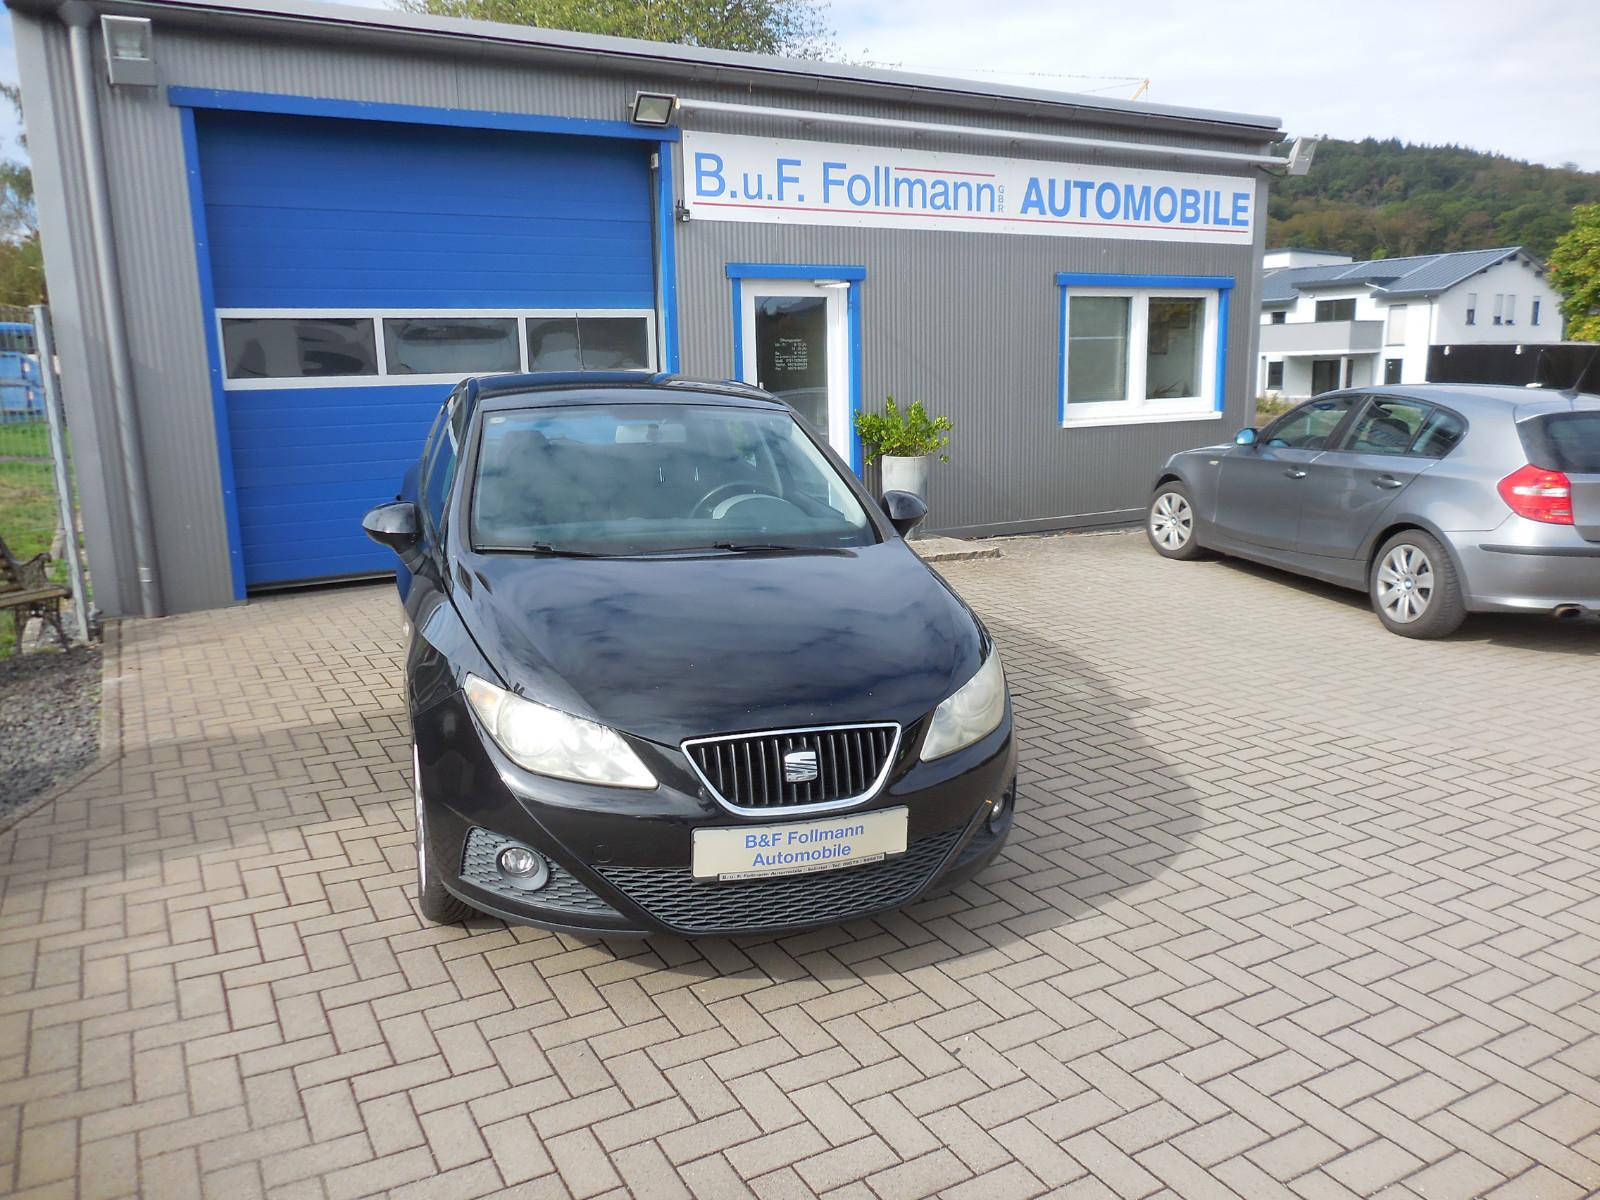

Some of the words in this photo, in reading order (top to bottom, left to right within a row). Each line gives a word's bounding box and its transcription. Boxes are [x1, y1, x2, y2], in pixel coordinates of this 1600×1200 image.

[695, 152, 805, 202] B.u.F.
[823, 162, 995, 212] Follmann
[1021, 176, 1250, 226] AUTOMOBILE
[745, 832, 783, 848] B&F
[787, 824, 865, 845] Follmann
[752, 844, 851, 867] Automobile
